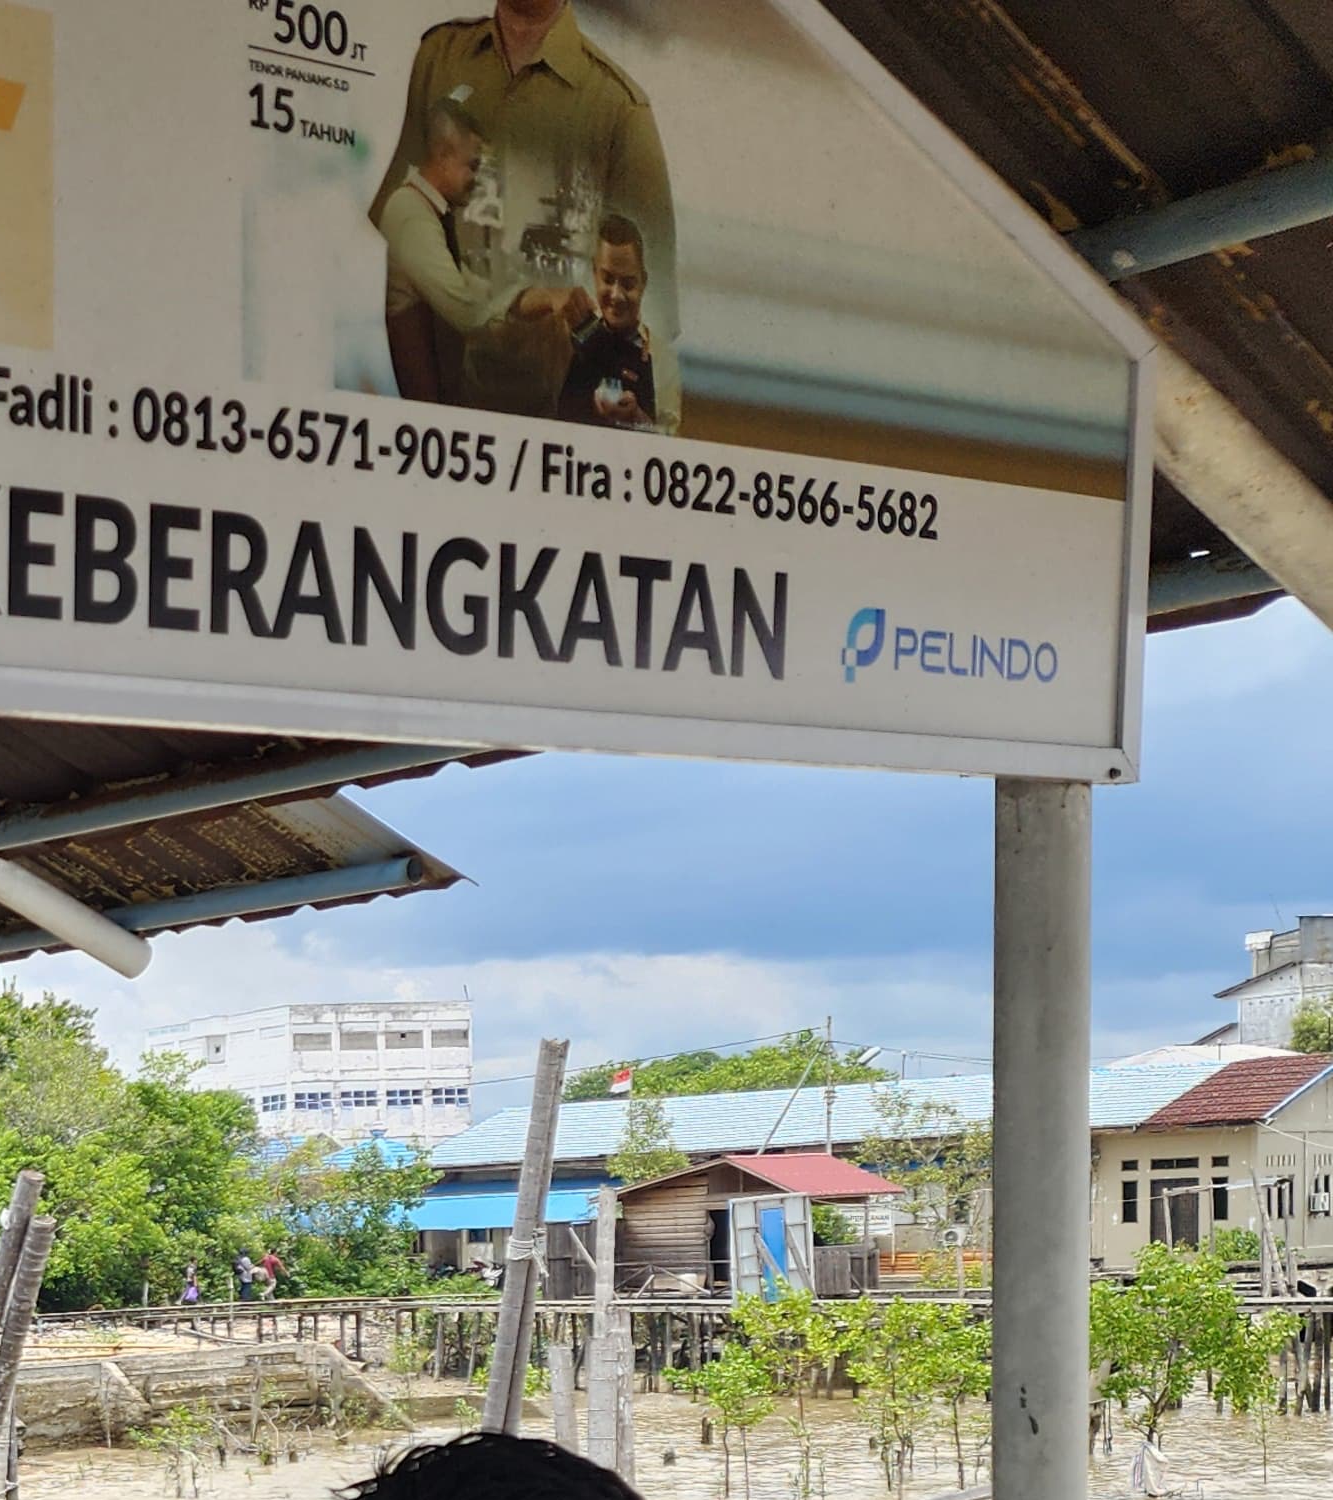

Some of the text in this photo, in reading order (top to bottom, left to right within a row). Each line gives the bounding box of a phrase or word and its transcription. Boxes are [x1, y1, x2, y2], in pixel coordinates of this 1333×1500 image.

[274, 0, 348, 56] 500
[350, 43, 367, 61] JT
[249, 59, 284, 78] TENOR
[285, 68, 332, 88] PANJANG
[249, 83, 356, 146] 15 TAHUN
[108, 399, 120, 438] :
[133, 386, 497, 487] 0813-6571-9055
[509, 438, 530, 492] /
[541, 443, 612, 501] Fira
[623, 469, 633, 502] :
[644, 456, 939, 540] 0822-8566-5682
[894, 626, 1058, 684] PELINDO
